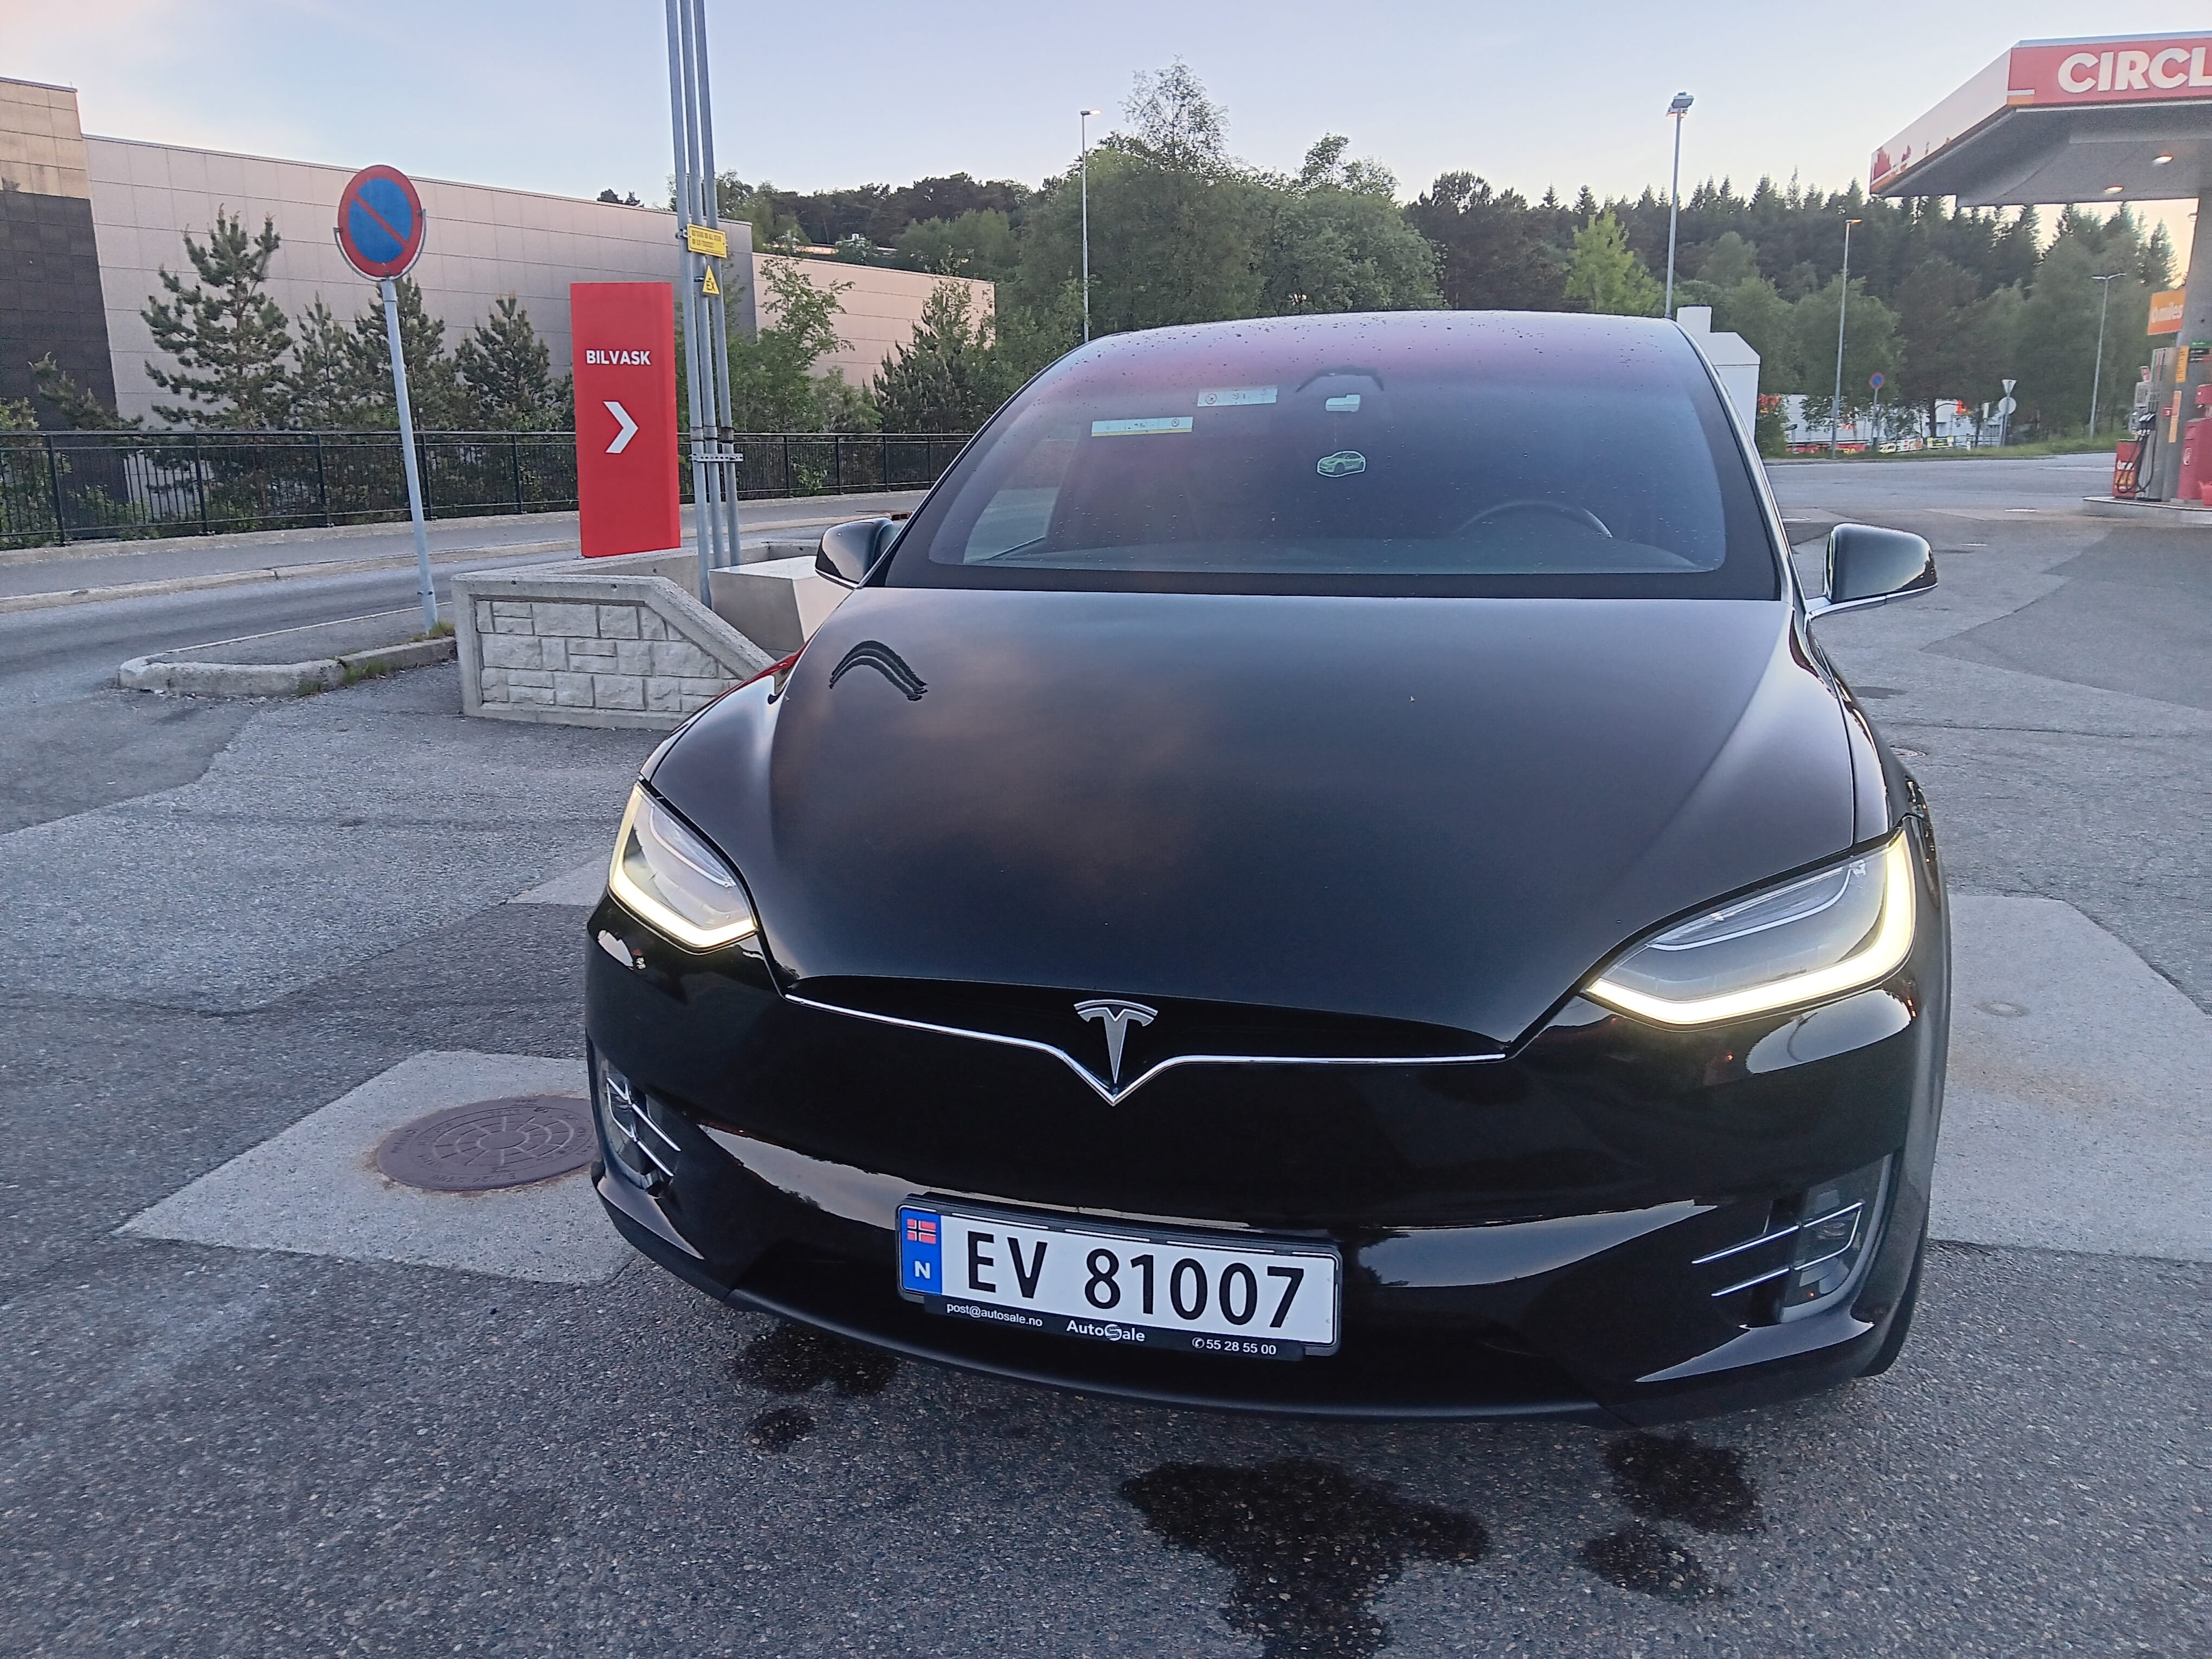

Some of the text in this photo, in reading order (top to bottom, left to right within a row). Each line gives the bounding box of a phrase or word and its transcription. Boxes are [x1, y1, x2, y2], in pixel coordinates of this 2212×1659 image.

[2058, 47, 2212, 93] CIRCL
[586, 350, 651, 365] BILVASK
[915, 1261, 930, 1279] N
[968, 1231, 1304, 1328] EV 81007
[947, 1303, 1043, 1327] post@autosale.no
[1066, 1320, 1146, 1342] AutoSale
[1206, 1339, 1277, 1355] 55 28 55 00
